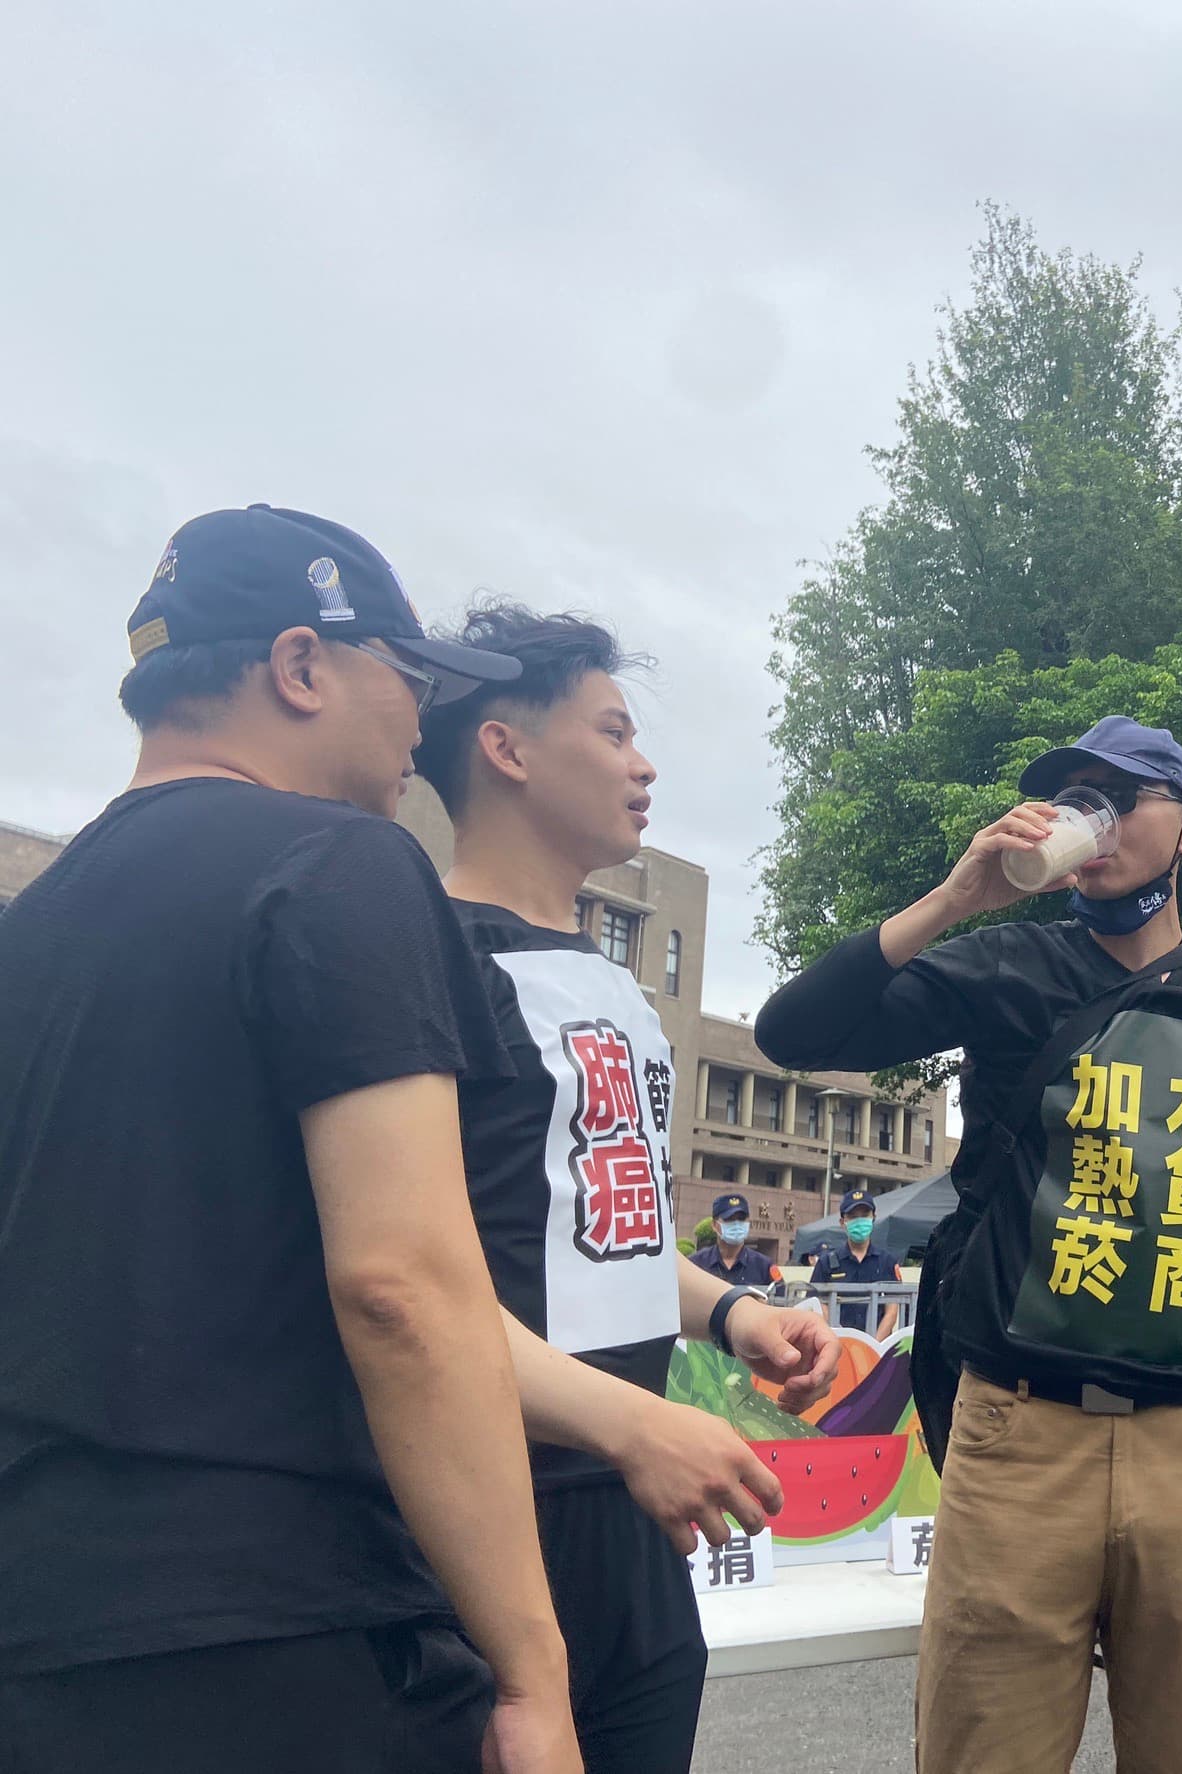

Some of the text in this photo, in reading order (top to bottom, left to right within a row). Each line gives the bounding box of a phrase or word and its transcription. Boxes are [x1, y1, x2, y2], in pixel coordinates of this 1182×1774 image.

[562, 1021, 662, 1259] 肺癌
[1048, 1053, 1143, 1305] 加熱菸
[689, 1535, 755, 1587] 捐
